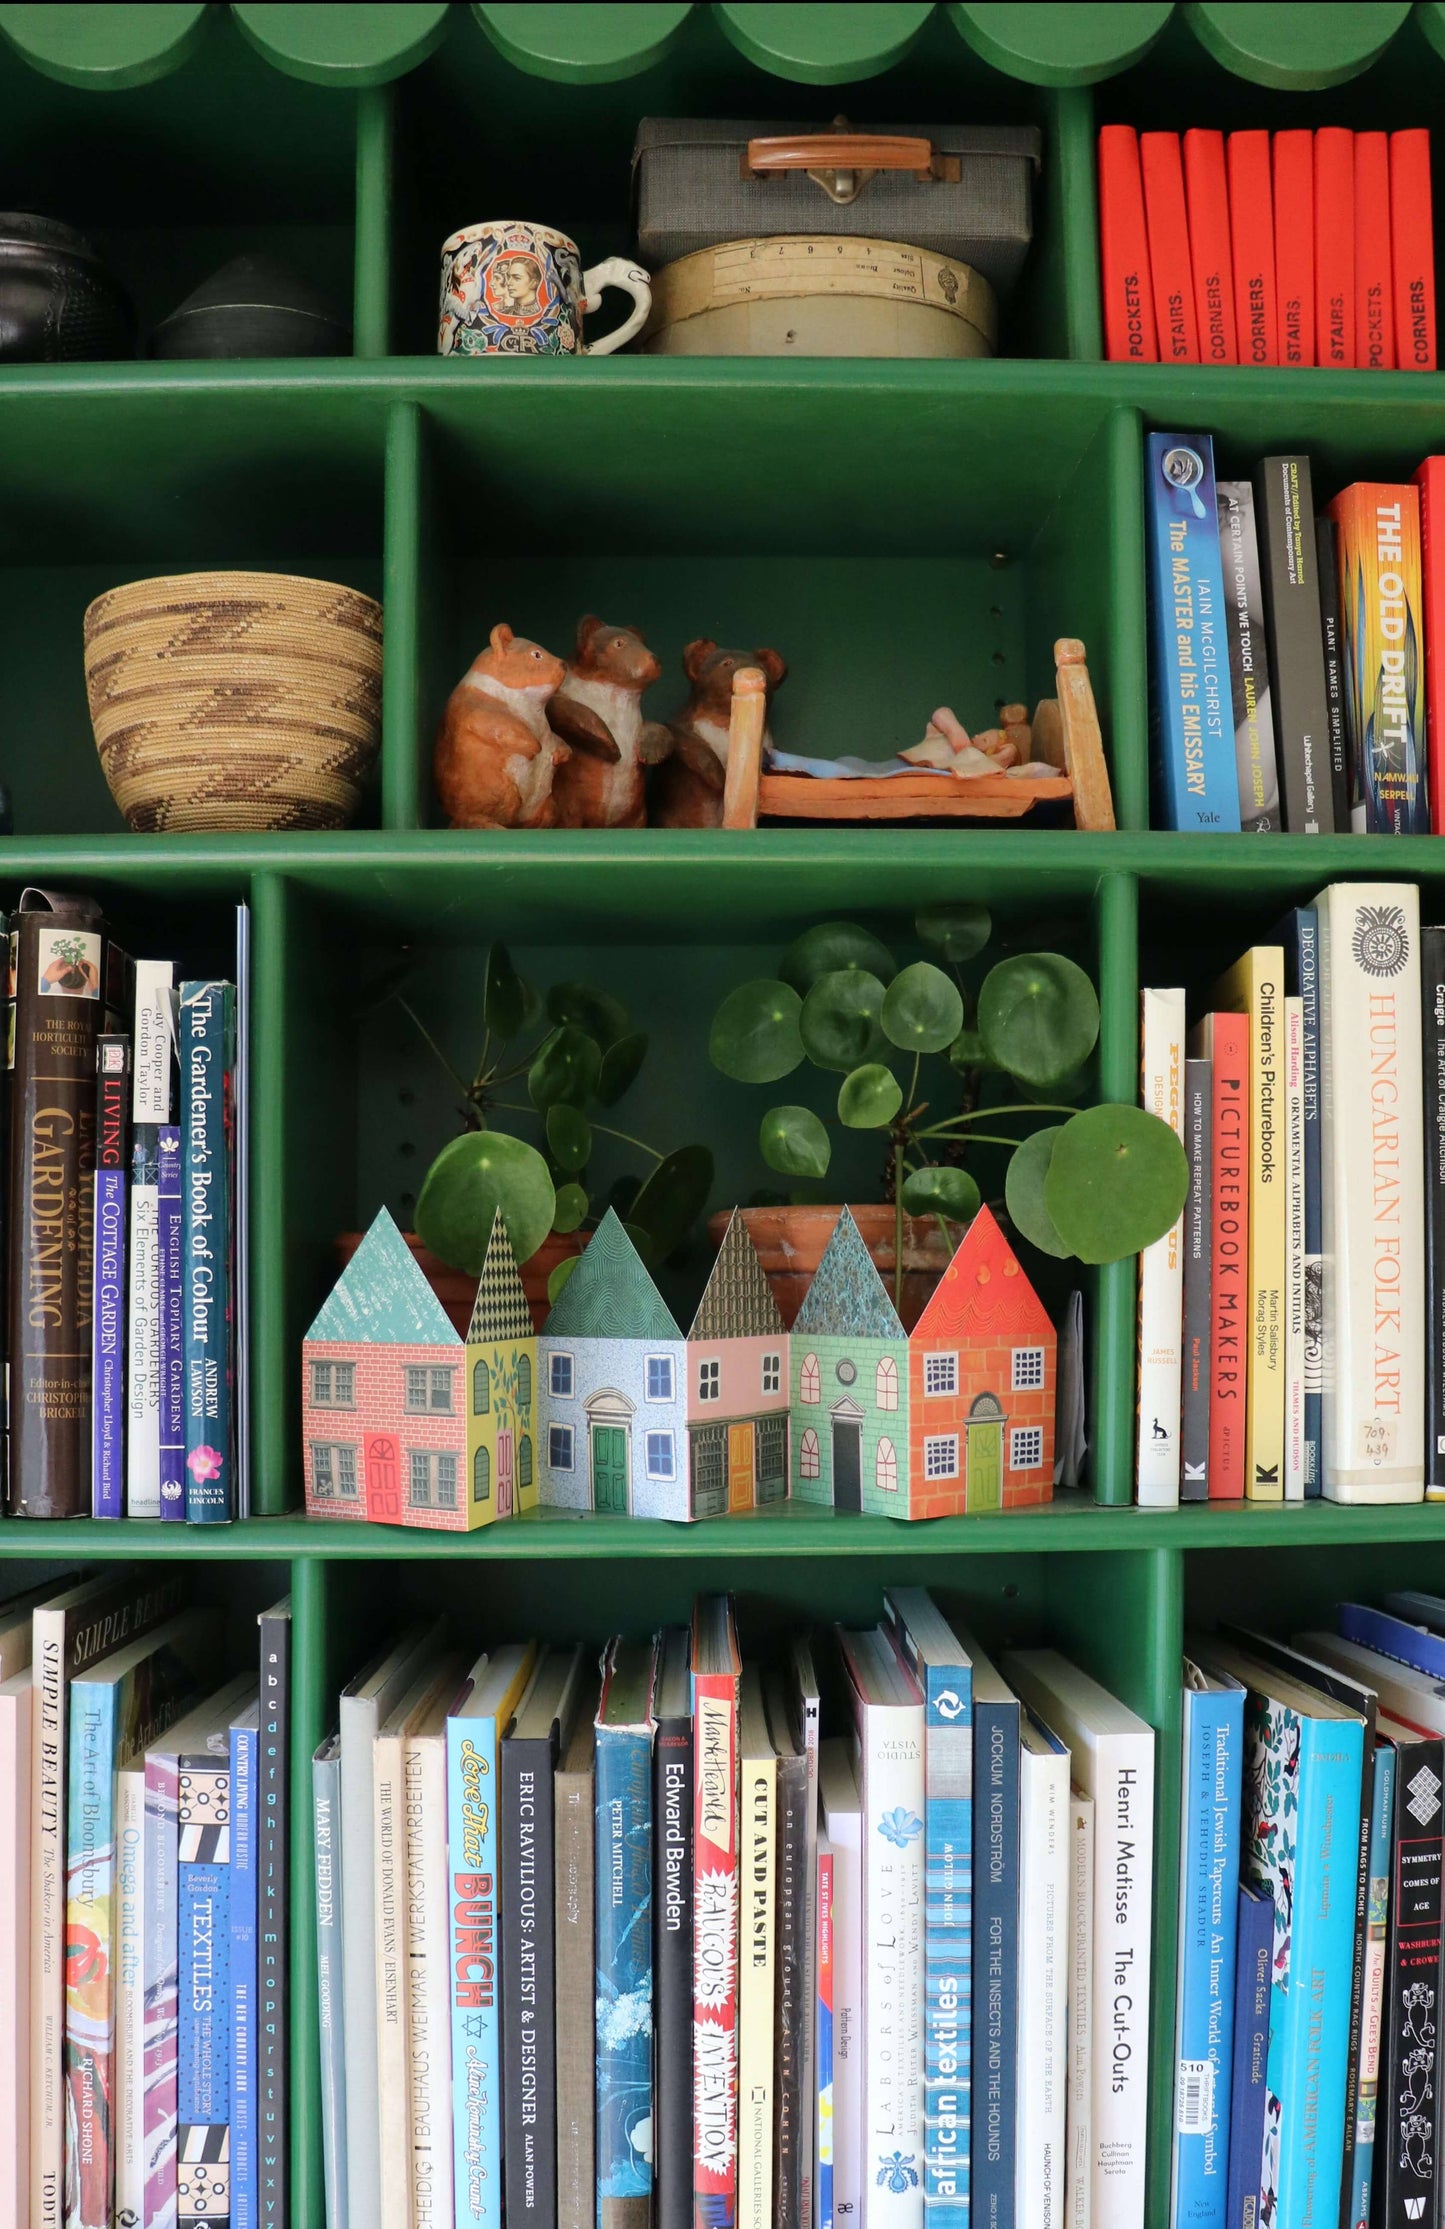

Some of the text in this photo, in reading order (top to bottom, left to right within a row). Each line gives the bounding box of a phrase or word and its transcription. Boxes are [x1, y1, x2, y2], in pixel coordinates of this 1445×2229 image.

[1124, 272, 1143, 356] POCKETS.
[1168, 290, 1188, 356] STAIRS.
[1206, 272, 1226, 359] CORNERS.
[1249, 273, 1268, 362] CORNERS.
[1287, 296, 1302, 362] STAIRS.
[1331, 293, 1345, 360] STAIRS.
[1368, 282, 1384, 368] POCKETS.
[1409, 276, 1429, 364] CORNERS.
[1169, 520, 1205, 796] The MASTER and his EMISSARY
[1198, 579, 1222, 737] IAIN McGILCHRIST
[1229, 497, 1264, 807] AT CERTAIN POINTS WE TOUCH LAUREN JOHN JOSEPH
[1377, 503, 1407, 743] THE OLD DRIFT
[1326, 617, 1343, 772] PLANT NAMES SIMPLIFIED
[1197, 812, 1221, 823] Yale
[1303, 735, 1315, 814] Whitechapel Gallery
[137, 1008, 153, 1105] Gordon Taylor
[1301, 927, 1318, 1120] DECORATIVE ALPHABETS
[102, 1080, 121, 1164] LIVING
[1260, 982, 1276, 1183] Children's Picturebooks
[191, 996, 213, 1343] The Gardener's Book of Colour
[1193, 1093, 1202, 1259] HOW TO MAKE REPEAT PATTERNS
[1289, 1012, 1302, 1334] Alison Harding ORNAMENTAL ALPHABETS AND INITIALS
[1369, 992, 1402, 1414] HUNGARIAN FOLK ART
[29, 1107, 74, 1329] GARDENING
[1218, 1079, 1240, 1400] PICTUREBOOK MAKERS
[131, 1200, 149, 1418] Six Elements of Garden Design
[170, 1215, 182, 1432] ENGLISH TOPIARY GARDENS
[1256, 1290, 1268, 1355] Morag Styles
[1268, 1290, 1279, 1370] Martin Salisbury
[191, 1360, 203, 1416] LAWSON
[205, 1358, 218, 1418] ANDREW
[73, 1606, 130, 1665] SIMPLE
[156, 1782, 166, 1829] BEYOND
[665, 1763, 685, 1841] Edward
[1214, 1724, 1230, 1801] Traditional
[1380, 1769, 1390, 1838] GOLDMAN RUBIN
[79, 1708, 101, 1908] The Art of Bloomsbury
[405, 1752, 425, 1944] WERKSTATTARBEITEN
[1197, 1725, 1211, 1948] JOSEPH & YEHUDIT SHADUR
[1213, 1806, 1228, 1853] Jewish
[119, 1828, 141, 1988] Omega and after
[156, 1834, 166, 1912] BLOOMSBURY
[454, 1740, 494, 2008] Love That BUNCH
[666, 1847, 686, 1931] Bawden
[753, 1778, 767, 1967] CUT AND PASTE
[1210, 1858, 1227, 1924] Papercuts
[1413, 1902, 1430, 1910] AGE
[988, 1725, 1005, 2161] JOCKUM NORDSTRÖM FOR THE INSECTS AND THE HOUNDS
[1112, 1768, 1137, 2093] Henri Matisse The Cut-Outs
[1211, 1933, 1224, 1954] An
[1398, 1938, 1442, 1948] WASHBURN
[193, 1898, 213, 2115] TEXTILES THE WHOLE STORY
[519, 1771, 536, 2208] ERIC RAVILIOUS: ARTIST & DESIGNER ALAN POWERS
[1208, 1999, 1222, 2043] World
[1210, 1958, 1223, 1996] Inner
[1251, 1948, 1268, 2084] Oliver Sacks Gratitude
[411, 1969, 431, 2136] BAUHAUS WEIMAR
[931, 1977, 958, 2196] african textiles
[1180, 2063, 1204, 2072] 510
[1207, 2048, 1221, 2064] of
[82, 2058, 93, 2164] RICHARD SHONE
[1360, 2181, 1369, 2216] ABRAMS
